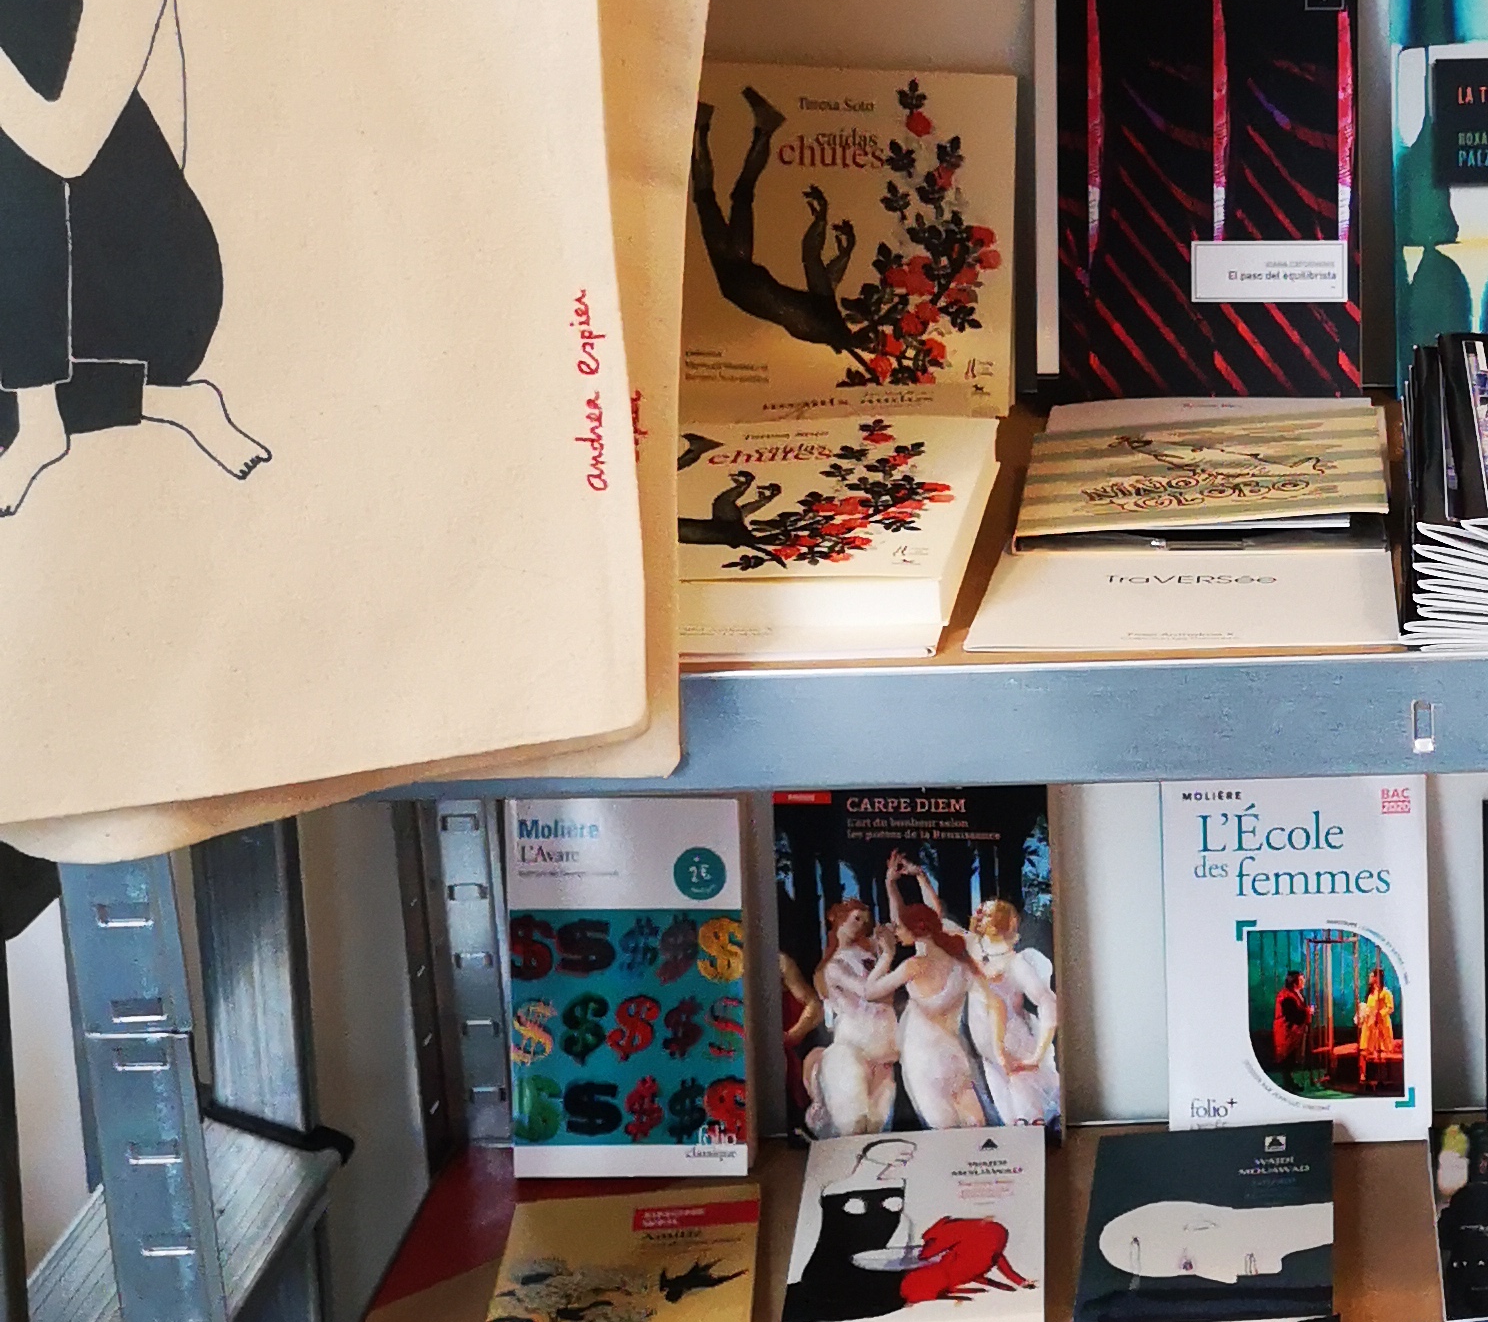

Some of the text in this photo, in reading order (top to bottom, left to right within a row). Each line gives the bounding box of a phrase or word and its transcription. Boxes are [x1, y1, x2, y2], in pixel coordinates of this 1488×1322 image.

[1457, 87, 1474, 105] LA
[777, 134, 886, 170] chutes
[1181, 790, 1243, 802] MOLIÈRE
[1380, 787, 1411, 800] BAC
[846, 797, 967, 815] CARPE DIEM
[518, 817, 600, 840] Molière
[939, 817, 970, 828] selon
[1195, 803, 1345, 854] L'École
[903, 829, 918, 840] de
[519, 845, 581, 864] L'Avare
[1193, 855, 1392, 897] des femmes
